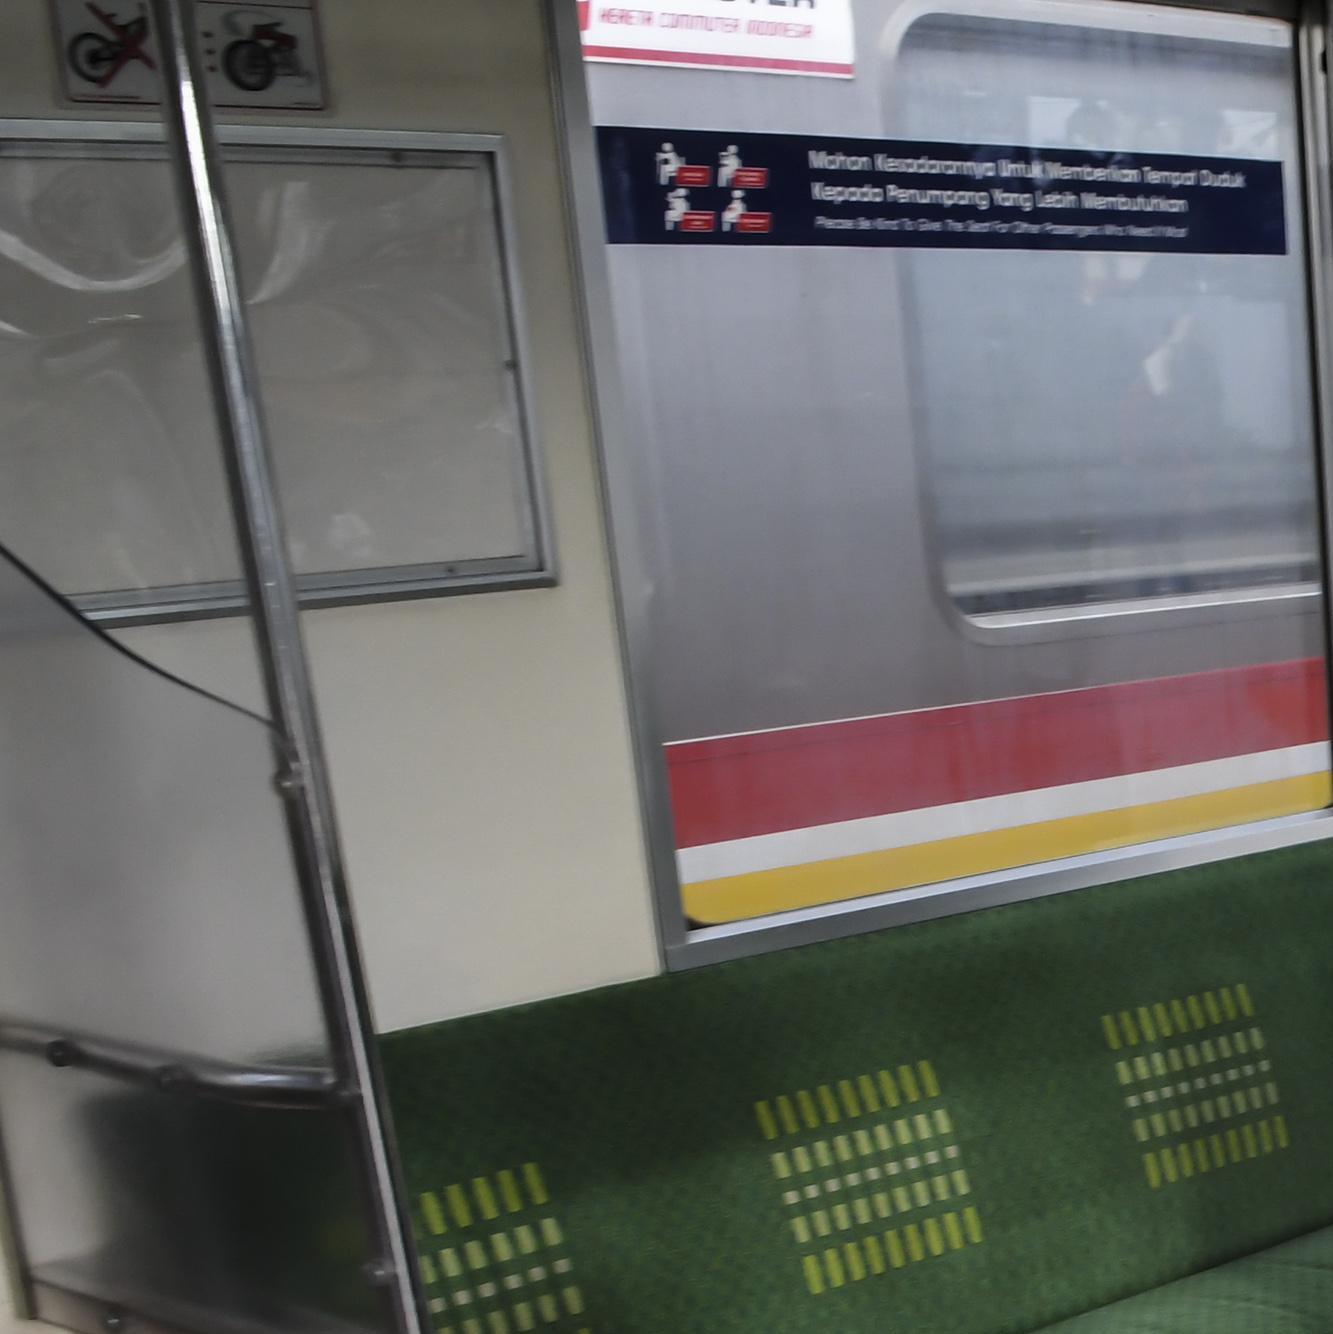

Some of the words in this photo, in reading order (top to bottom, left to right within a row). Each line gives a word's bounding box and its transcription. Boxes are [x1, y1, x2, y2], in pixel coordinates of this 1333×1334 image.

[808, 150, 872, 171] Mohon
[1141, 166, 1198, 188] Tempat
[1199, 169, 1247, 188] Duduk
[810, 182, 884, 205] Kepada
[885, 184, 990, 210] Penumpang
[990, 188, 1034, 212] Yang
[1035, 190, 1079, 209] Lebih
